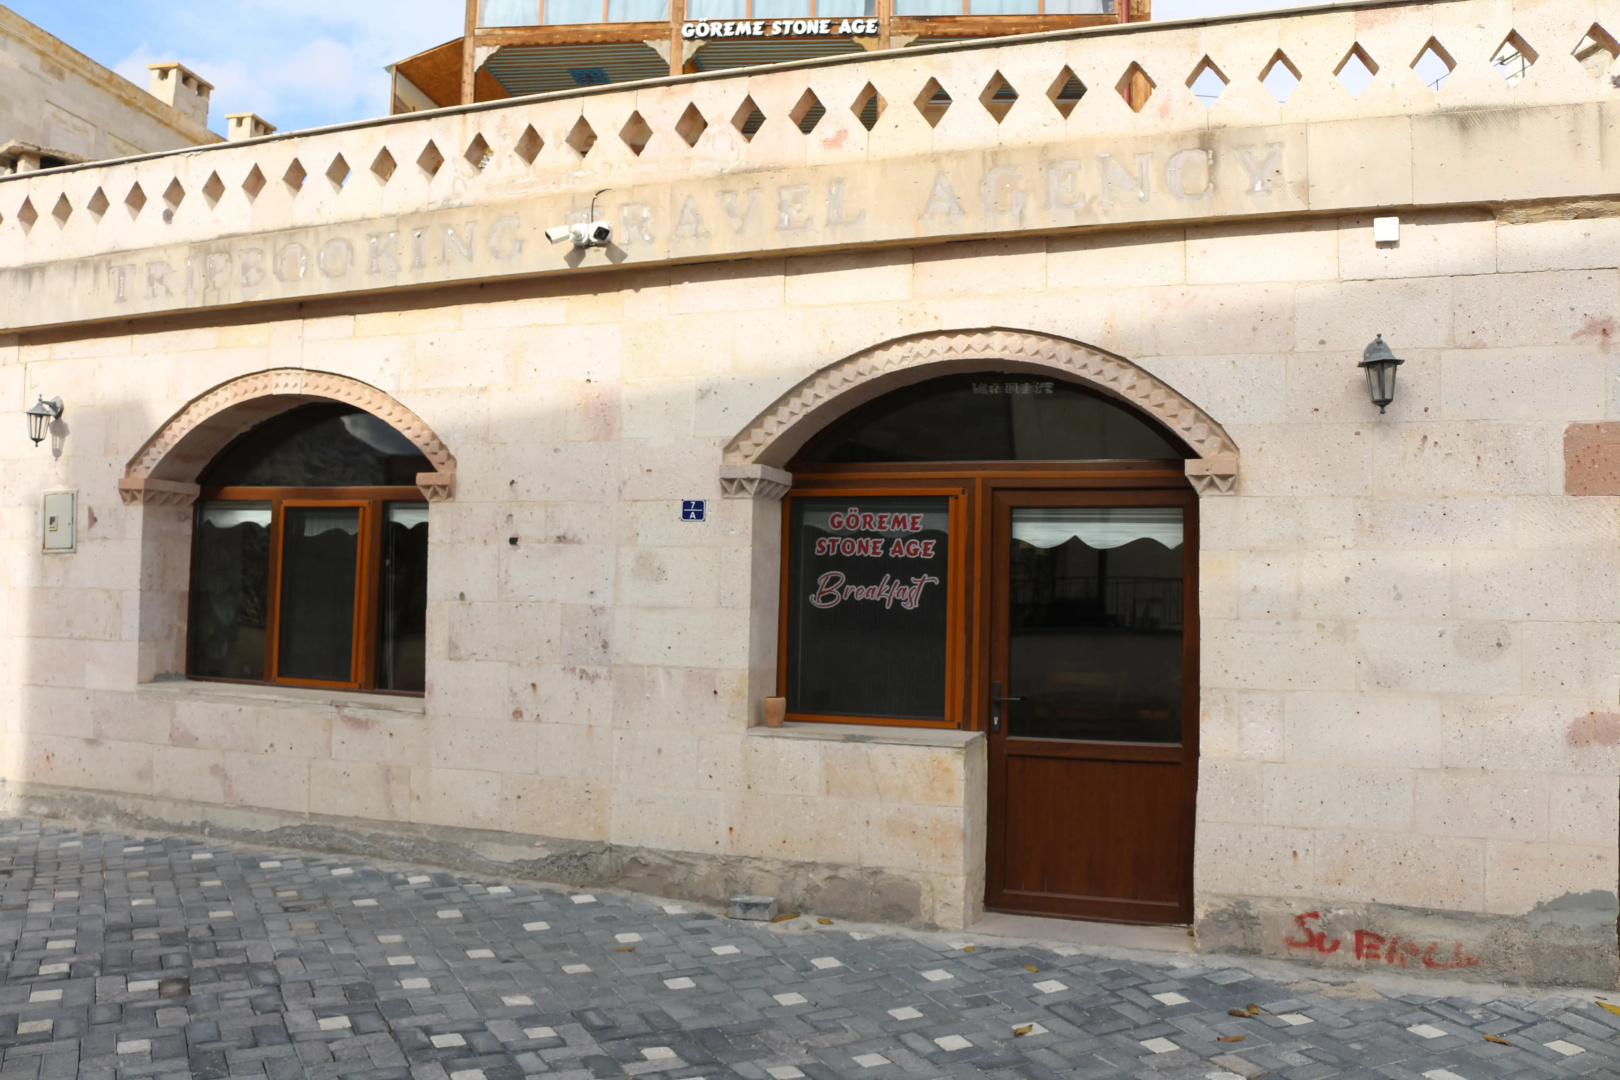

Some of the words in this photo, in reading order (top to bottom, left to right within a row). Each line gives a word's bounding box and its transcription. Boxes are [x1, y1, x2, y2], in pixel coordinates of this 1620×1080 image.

[681, 18, 764, 37] GÖREME
[771, 20, 831, 35] STONE
[838, 19, 878, 34] AGE
[916, 141, 1285, 220] AGENCY
[689, 511, 696, 519] A
[690, 501, 696, 509] 7
[829, 508, 923, 532] GÖREME
[815, 537, 884, 557] STONE
[889, 539, 936, 558] AGE
[809, 571, 939, 609] Breakfast
